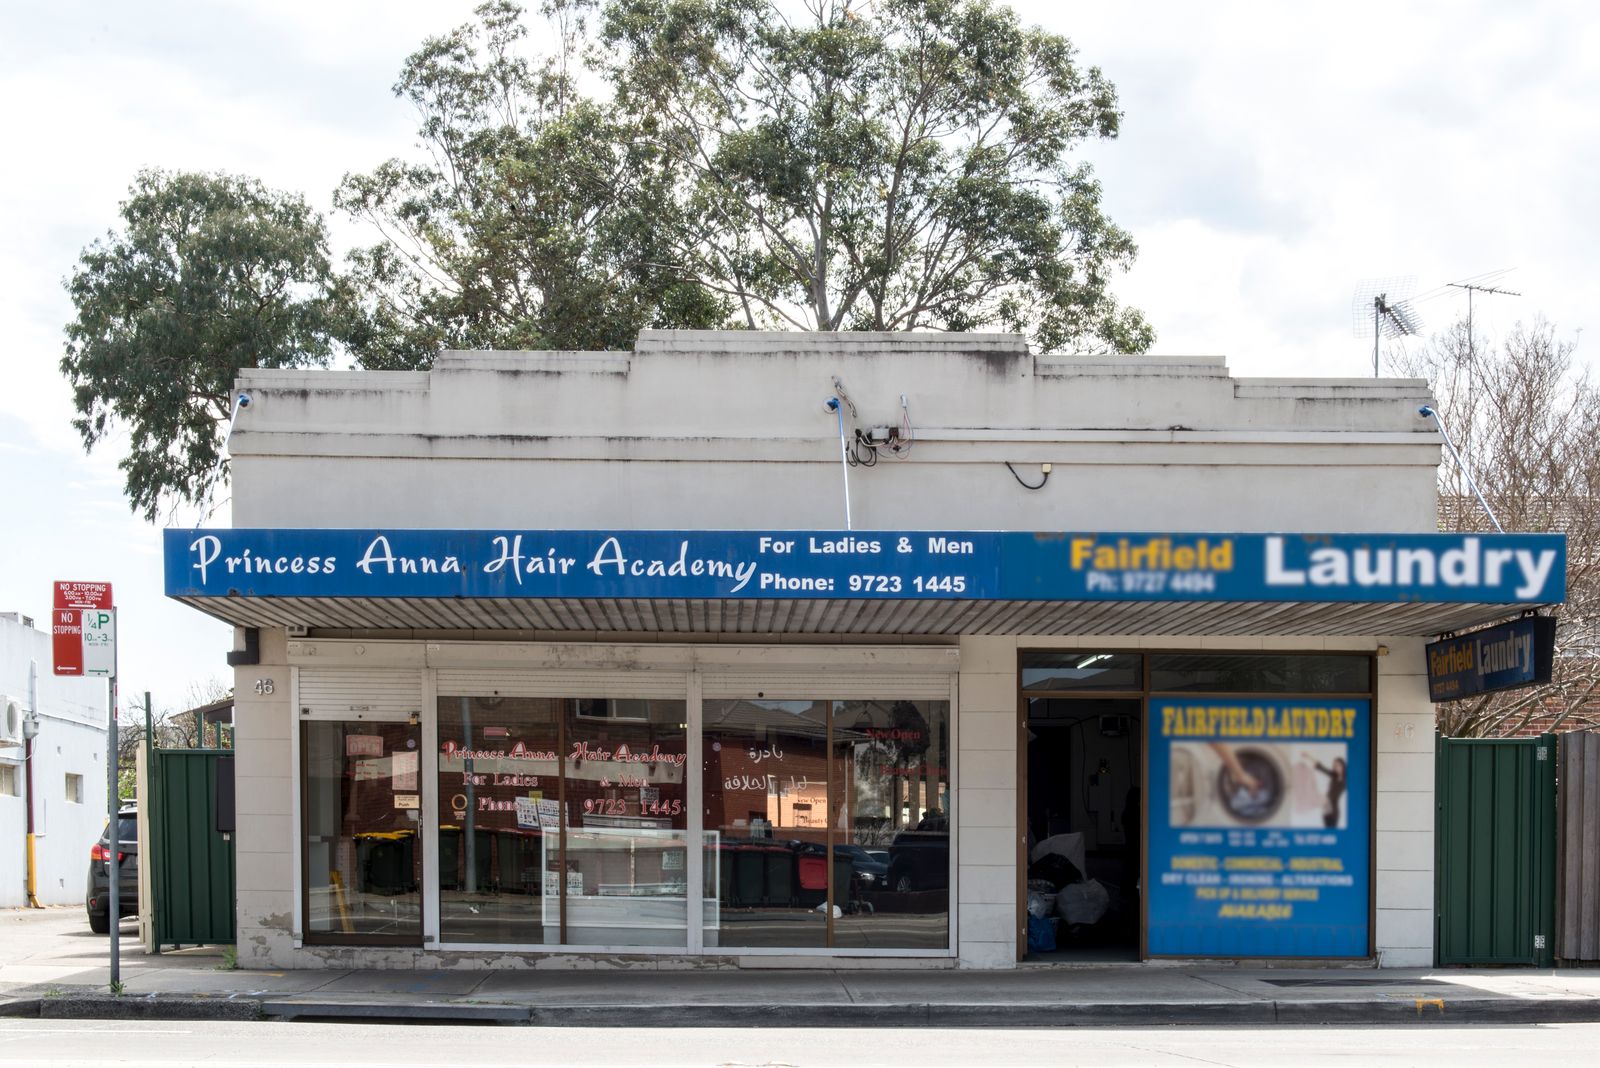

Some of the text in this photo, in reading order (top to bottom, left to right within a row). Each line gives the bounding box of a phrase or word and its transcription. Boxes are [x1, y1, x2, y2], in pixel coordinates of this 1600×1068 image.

[759, 537, 974, 554] For Ladies & Men
[1070, 538, 1234, 571] Fairfield
[190, 534, 757, 593] Princess Anna Hair Academy
[1263, 535, 1557, 600] Laundry
[73, 584, 106, 592] STOPPING
[759, 573, 966, 593] Phone: 9723 1445
[1122, 571, 1168, 592] 9727
[61, 612, 73, 623] NO
[53, 625, 81, 635] STOPPING
[1430, 630, 1531, 677] Fairfield Laundry
[1161, 706, 1357, 738] FAIRFIELD LAUNDRY
[891, 728, 921, 741] Open
[441, 739, 687, 767] Princess Anna Hair Academy
[462, 771, 650, 787] For Ladies & Men
[583, 798, 627, 815] 9723
[640, 799, 682, 816] 1445
